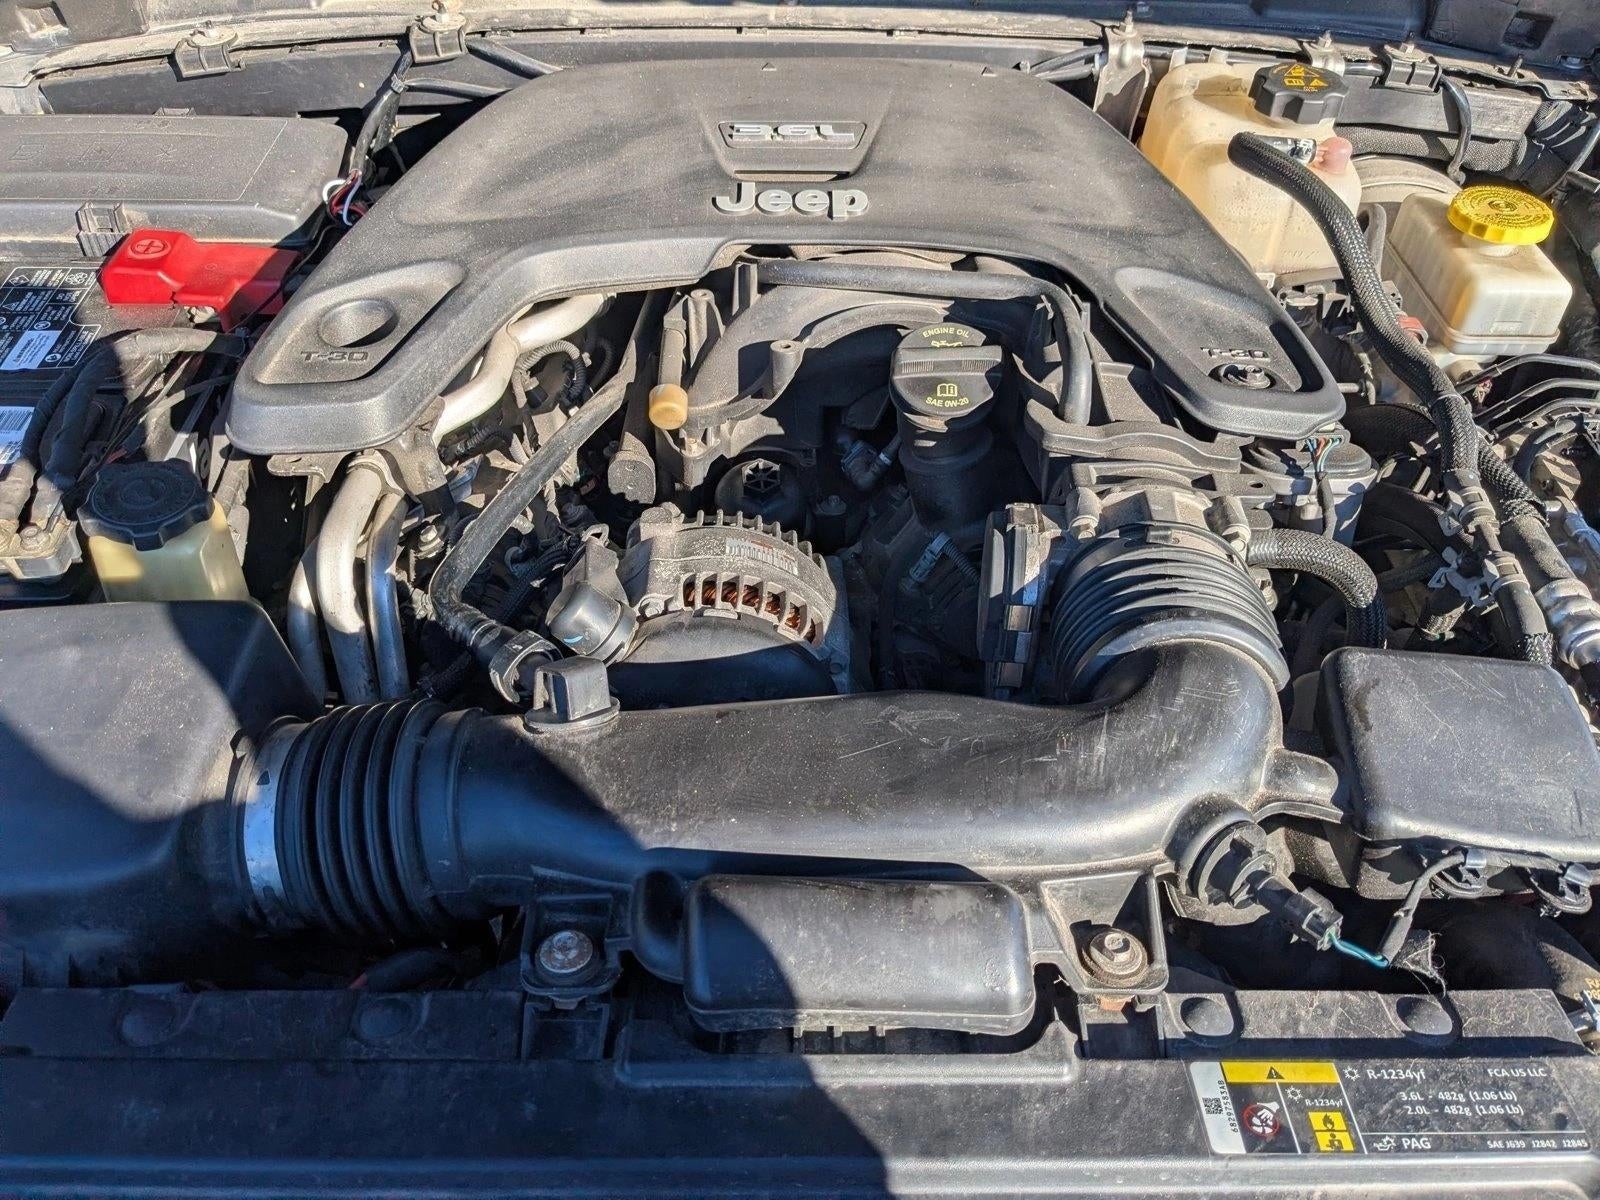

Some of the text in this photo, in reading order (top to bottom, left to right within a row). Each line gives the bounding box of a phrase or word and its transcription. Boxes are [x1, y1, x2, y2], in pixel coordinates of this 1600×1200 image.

[712, 182, 869, 221] Jeep
[922, 327, 971, 338] ENGINE OIL
[300, 350, 369, 364] T-30
[925, 396, 970, 408] SAE 0W-20
[1366, 1068, 1426, 1082] R-1234yf
[1487, 1068, 1548, 1077] FCA US LLC
[1400, 1091, 1425, 1101] 3.6L
[1438, 1091, 1466, 1103] 482g
[1468, 1090, 1498, 1102] (1.06
[1498, 1090, 1518, 1102] Lb)
[1305, 1098, 1345, 1108] R-1234yf
[1406, 1105, 1431, 1115] 2.0L
[1443, 1105, 1472, 1117] 482g
[1475, 1104, 1505, 1116] (1.06
[1505, 1104, 1525, 1116] Lb)
[1401, 1137, 1432, 1149] PAG
[1486, 1140, 1505, 1149] SAE
